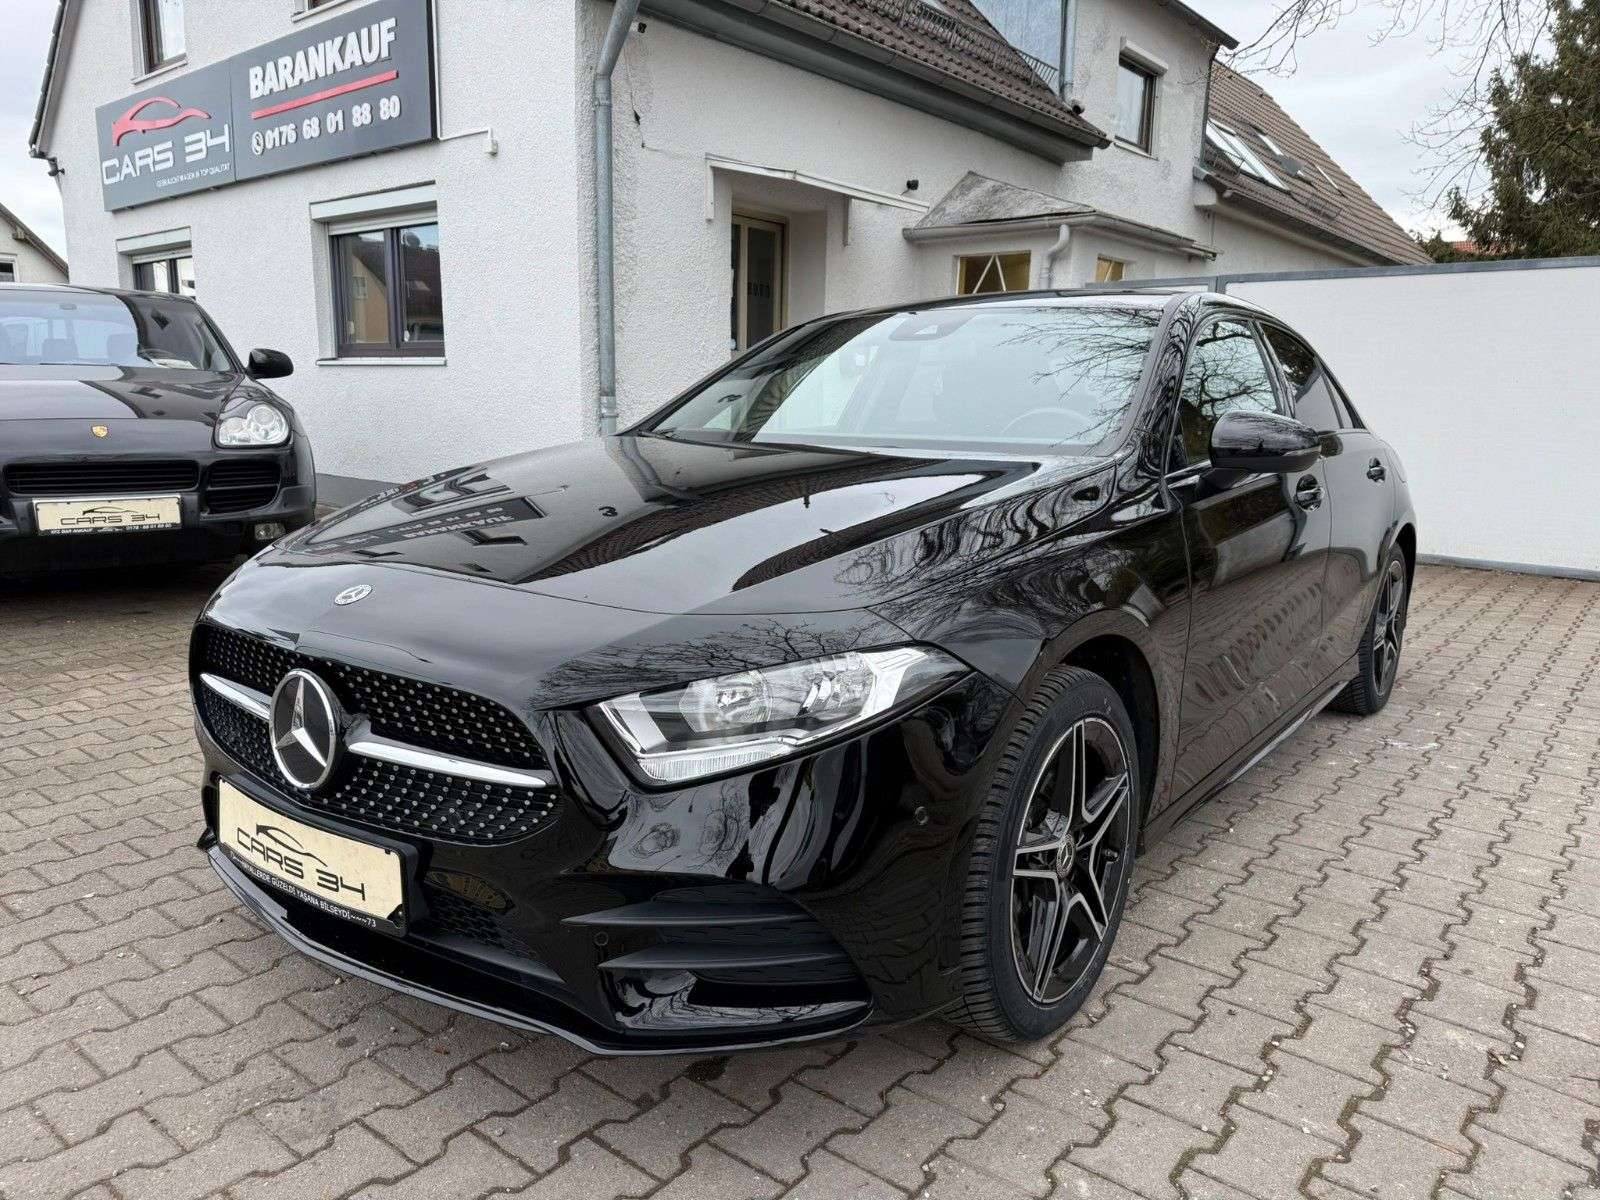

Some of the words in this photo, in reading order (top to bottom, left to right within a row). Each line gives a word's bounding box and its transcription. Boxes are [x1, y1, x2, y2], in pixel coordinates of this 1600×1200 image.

[249, 17, 397, 99] BARANKAUF
[265, 123, 298, 150] 0176
[302, 116, 322, 140] 68
[326, 109, 346, 134] 01
[351, 102, 373, 128] 88
[379, 95, 402, 121] 80
[101, 140, 175, 186] CARS
[184, 123, 231, 163] 34
[60, 514, 123, 526] CARS
[131, 512, 161, 523] 34
[237, 827, 305, 879] CARS
[316, 868, 366, 901] 34
